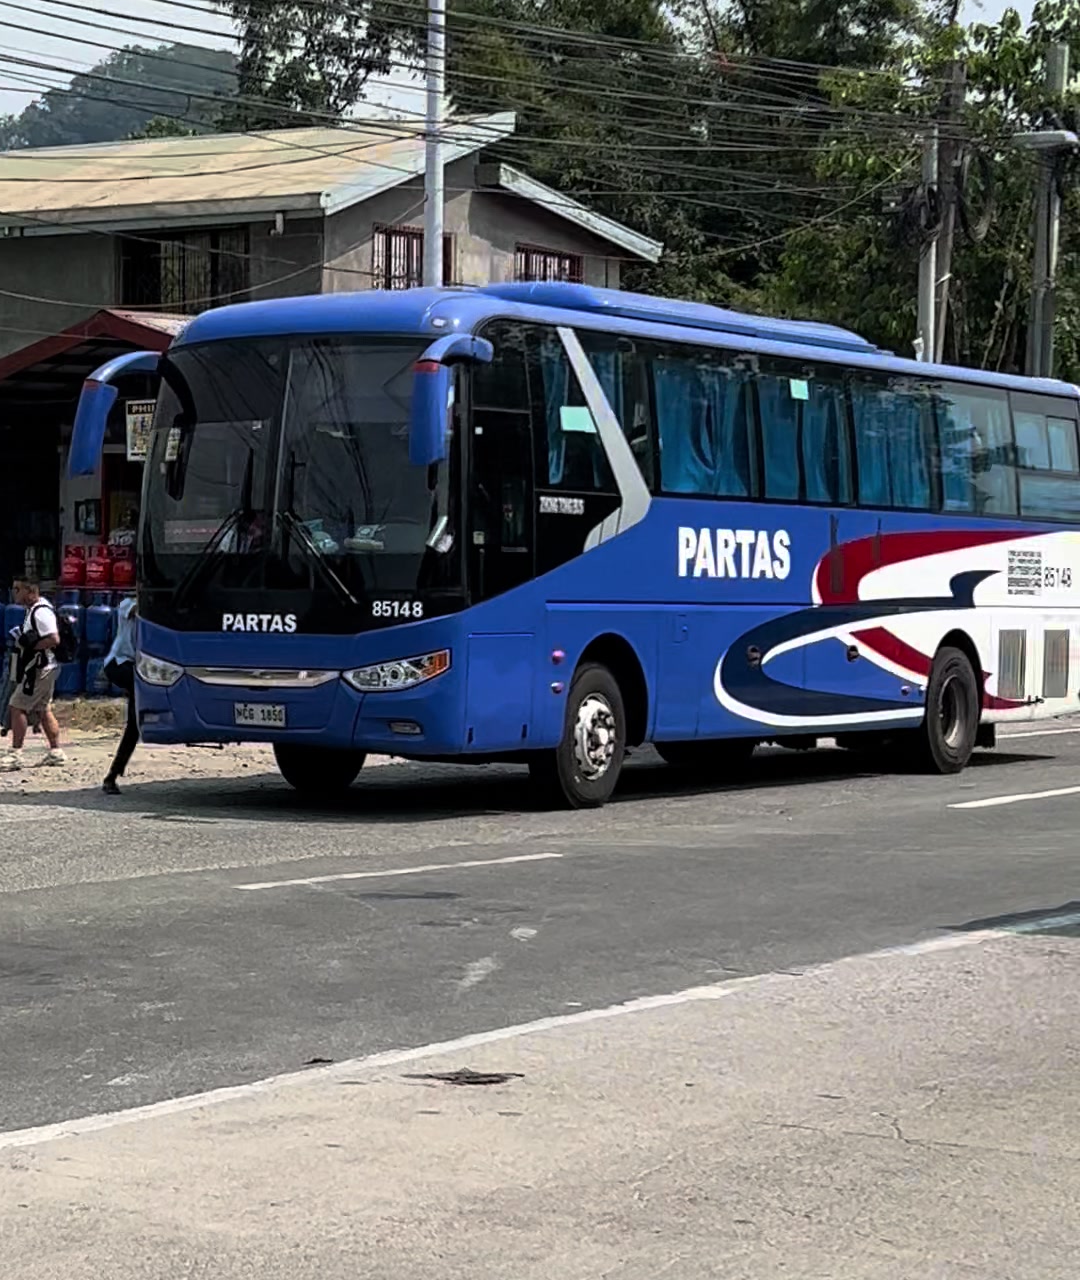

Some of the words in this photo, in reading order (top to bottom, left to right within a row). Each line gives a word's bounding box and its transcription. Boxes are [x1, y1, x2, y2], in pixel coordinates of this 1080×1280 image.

[678, 526, 791, 580] PARTAS
[372, 600, 423, 618] 85148
[222, 613, 297, 633] PARTAS
